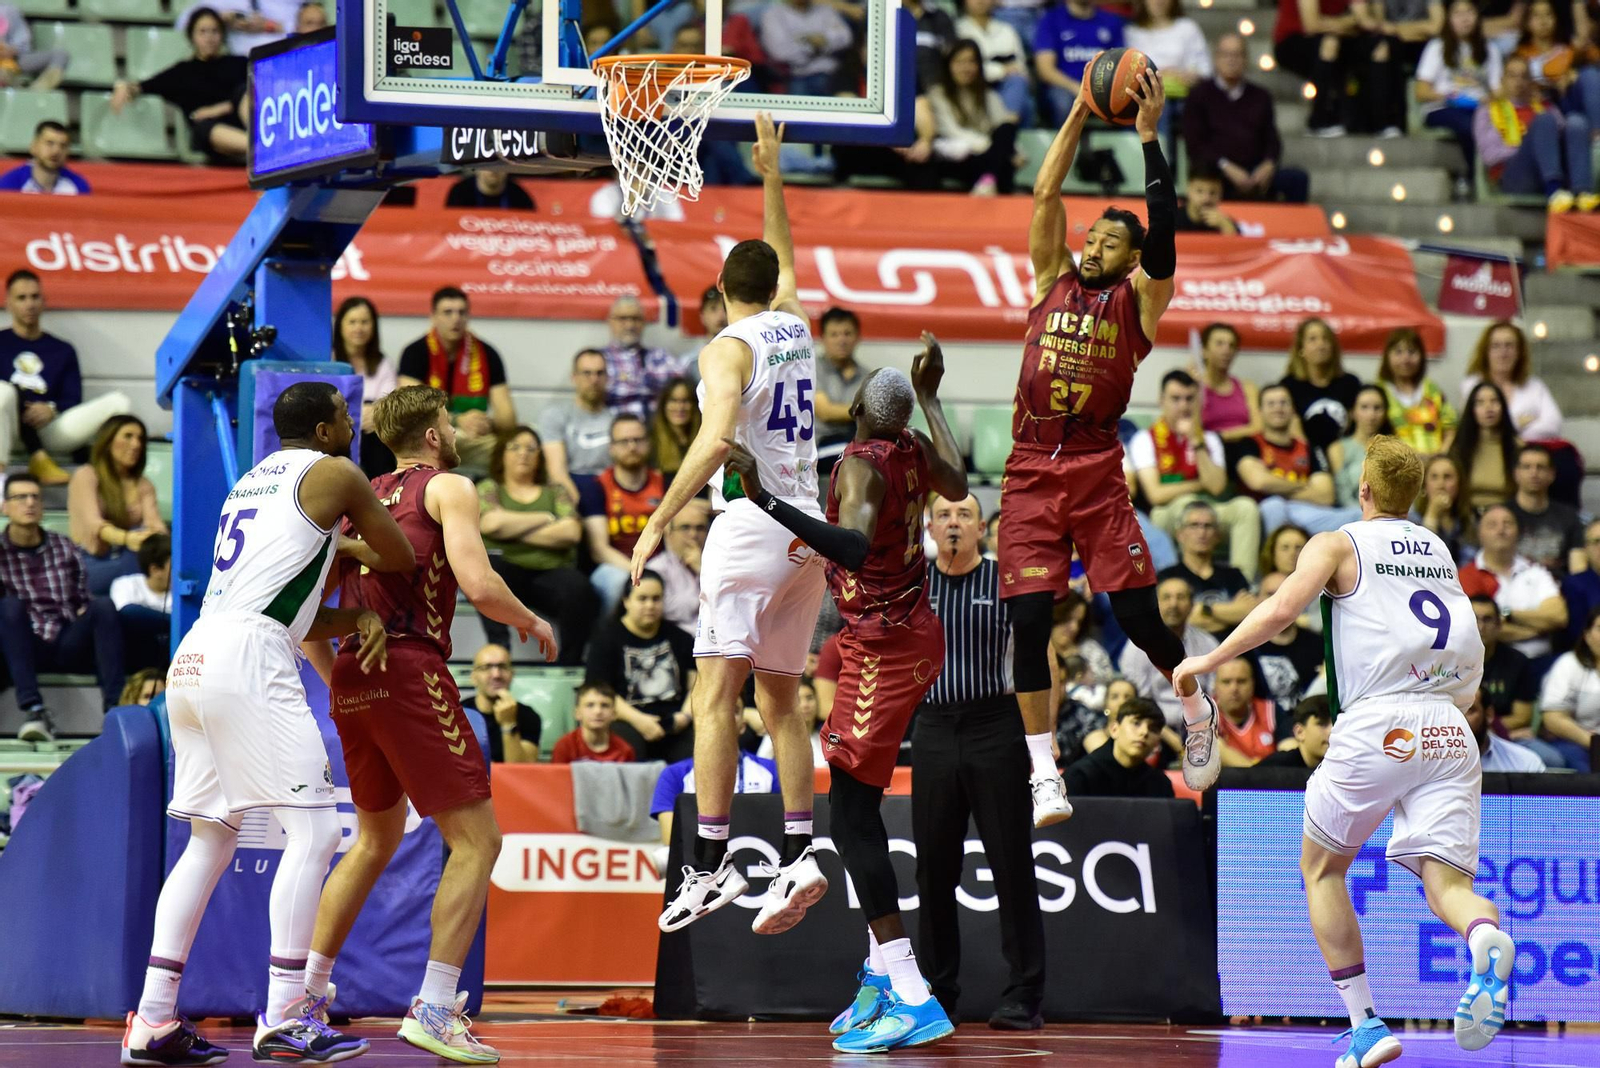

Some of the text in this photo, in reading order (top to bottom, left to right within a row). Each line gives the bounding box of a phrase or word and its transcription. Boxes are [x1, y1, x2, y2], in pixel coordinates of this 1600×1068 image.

[393, 38, 420, 54] liga
[393, 52, 451, 67] endesa
[260, 69, 344, 148] ende
[556, 235, 617, 257] para
[488, 257, 592, 278] cocinas
[760, 323, 807, 345] KRAVISH
[1045, 311, 1119, 345] UCAM
[1039, 333, 1117, 359] UNIVERSIDAD
[1049, 378, 1093, 414] 27
[766, 378, 814, 443] 45
[1390, 536, 1434, 556] DÍAZ
[1375, 562, 1454, 580] BENAHAVÍS
[1408, 589, 1452, 650] 9
[336, 695, 360, 706] Costa
[1421, 726, 1466, 738] COSTA
[1422, 738, 1468, 750] DEL SOL
[1421, 749, 1469, 762] MÁLAGA
